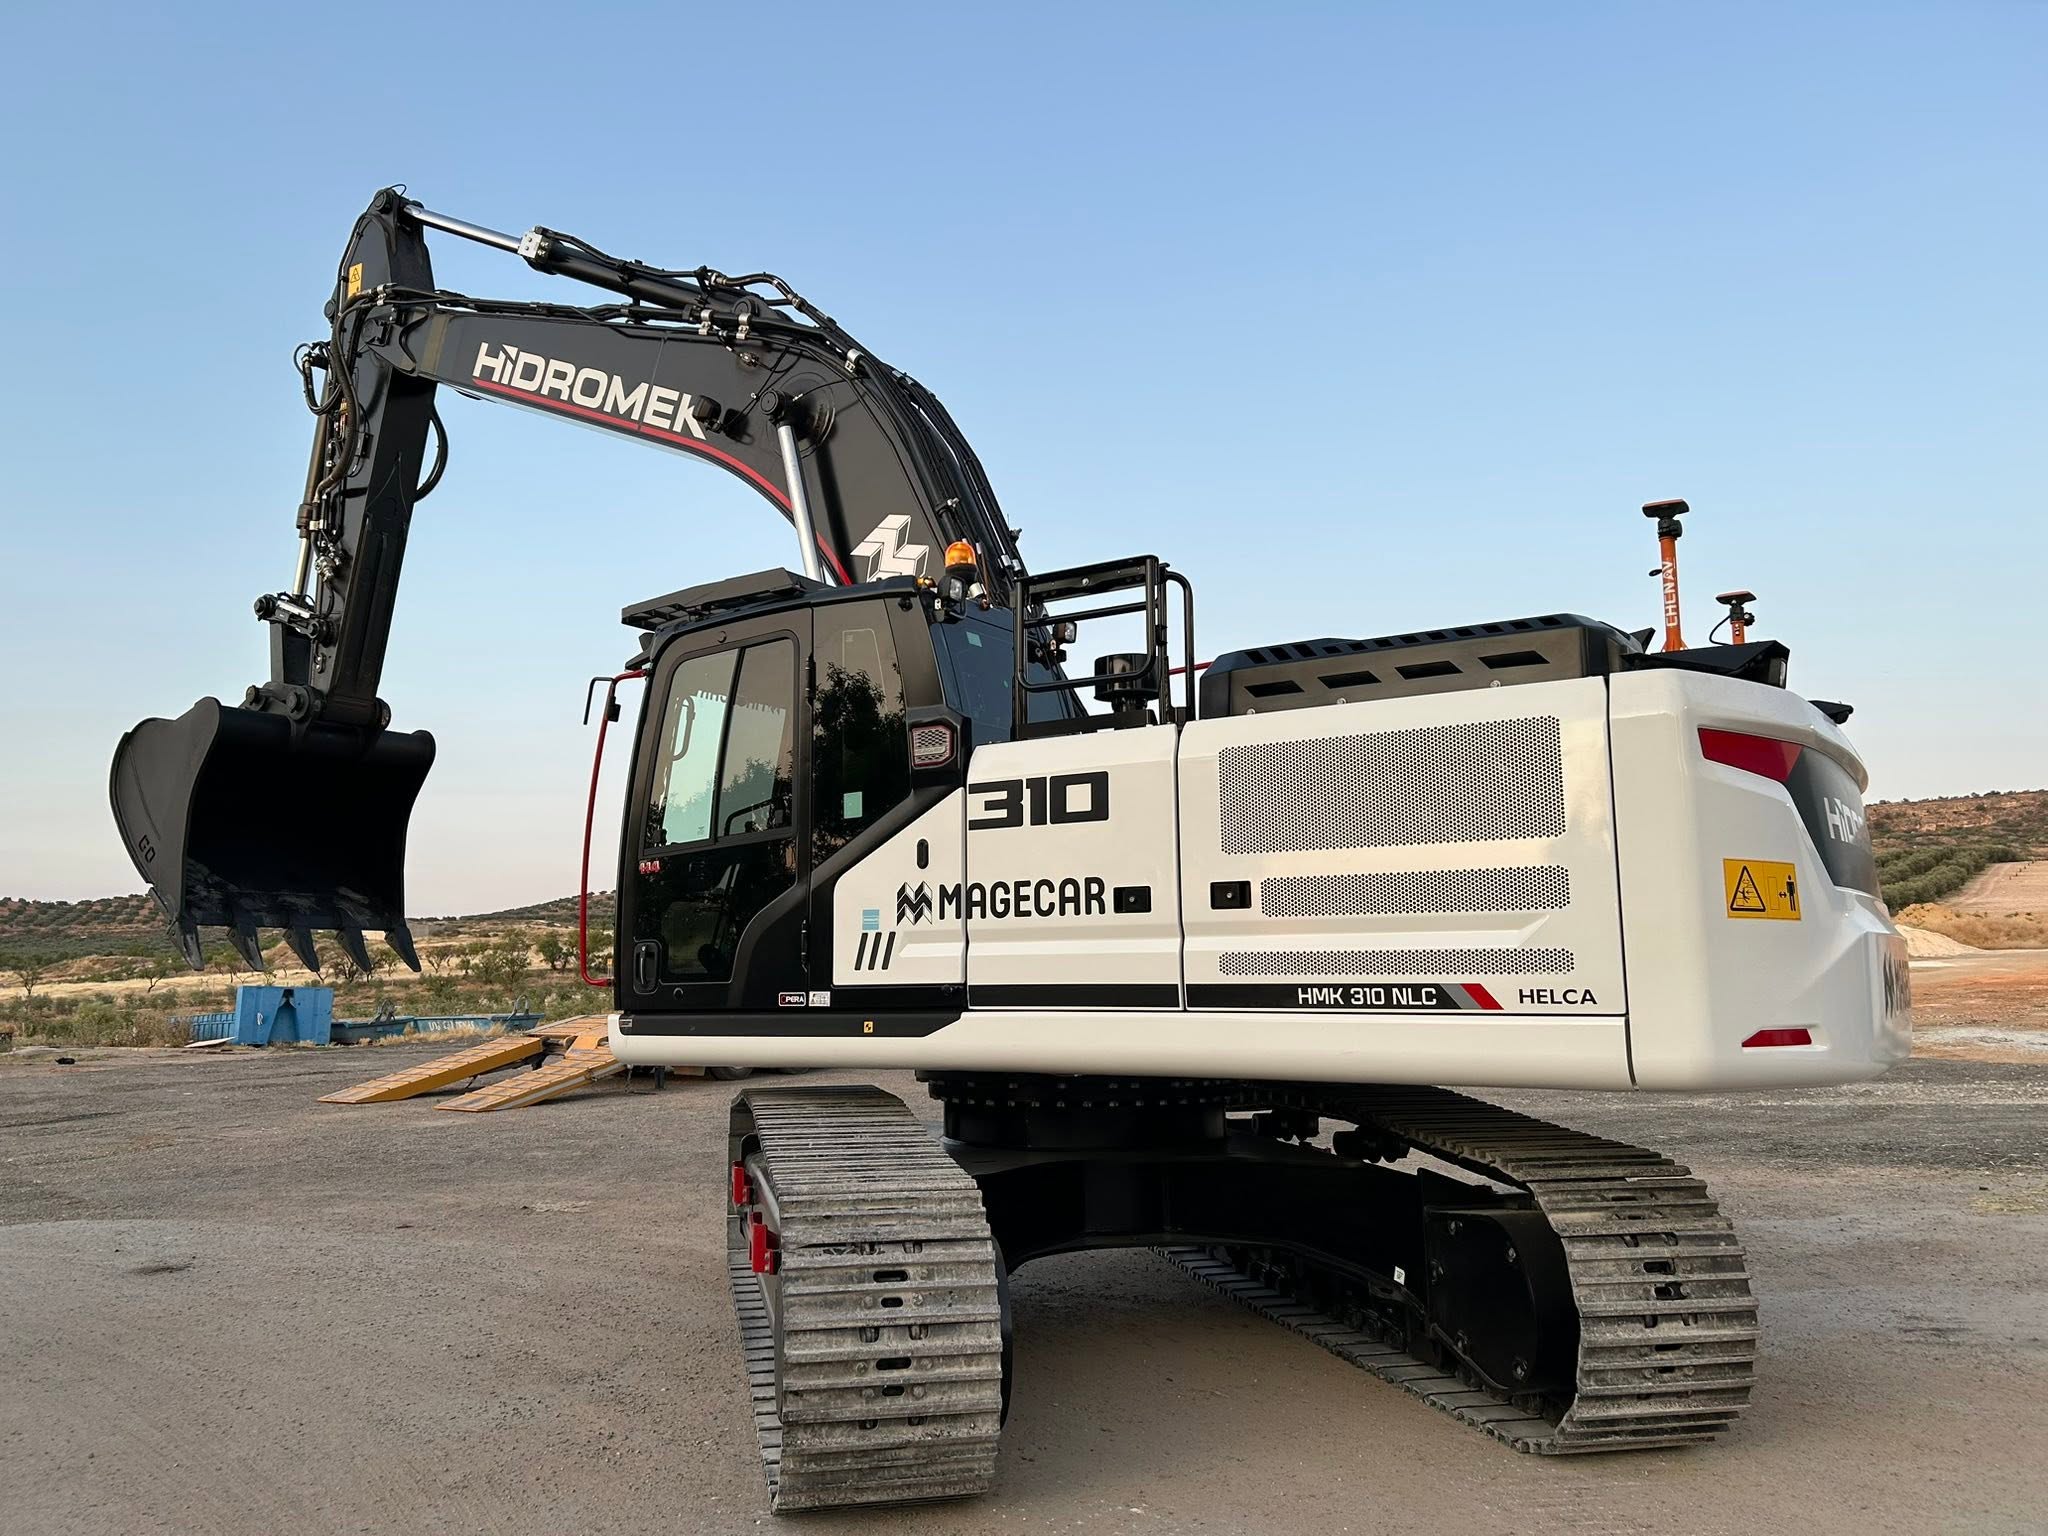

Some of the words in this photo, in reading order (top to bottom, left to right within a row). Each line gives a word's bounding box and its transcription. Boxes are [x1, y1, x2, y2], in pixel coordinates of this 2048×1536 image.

[968, 772, 1109, 830] 310
[938, 876, 1106, 920] MAGECAR
[1298, 987, 1344, 1005] HMK
[1351, 987, 1385, 1005] 310
[1392, 988, 1437, 1006] NLC
[1518, 988, 1598, 1005] HELCA
